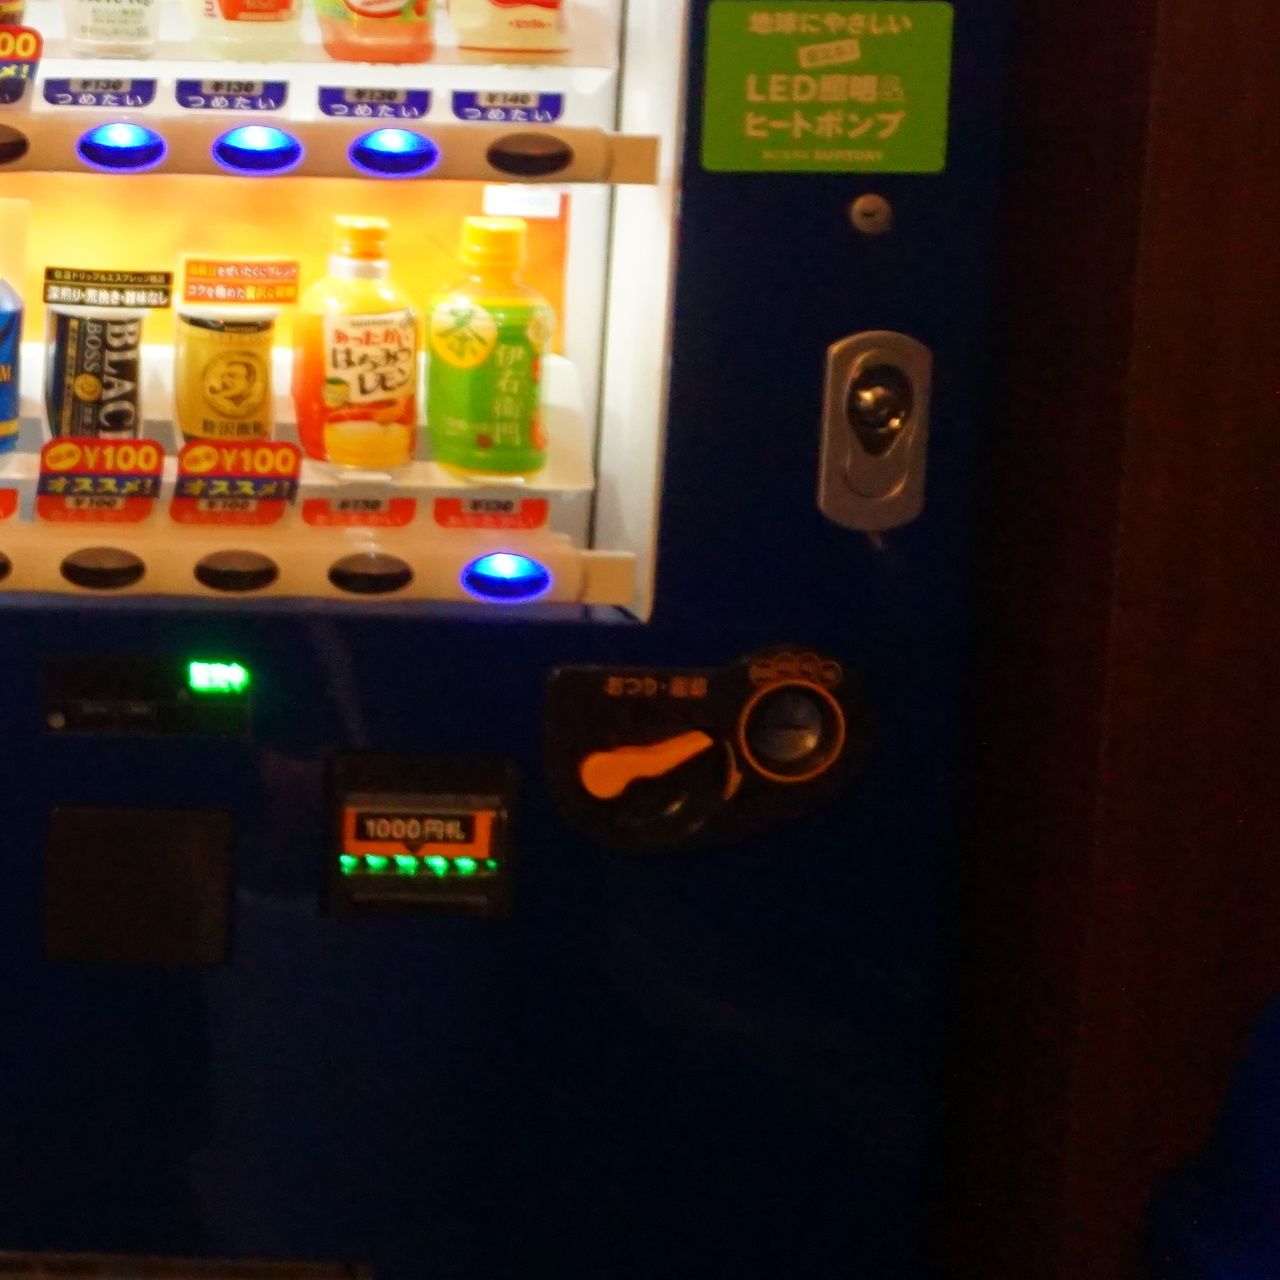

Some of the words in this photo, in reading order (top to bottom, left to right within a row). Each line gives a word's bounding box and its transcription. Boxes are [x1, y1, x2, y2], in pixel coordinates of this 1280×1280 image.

[748, 10, 913, 35] 地球にやさしい
[56, 93, 143, 106] つめたい
[188, 95, 275, 109] つめたい
[330, 104, 420, 118] つめたい
[462, 107, 552, 122] つめたい
[744, 109, 906, 139] ヒートポンプ
[435, 305, 490, 360] 茶
[357, 369, 411, 397] レモン
[83, 444, 159, 469] ¥100
[222, 447, 296, 473] ¥100
[47, 476, 152, 494] オススメ!
